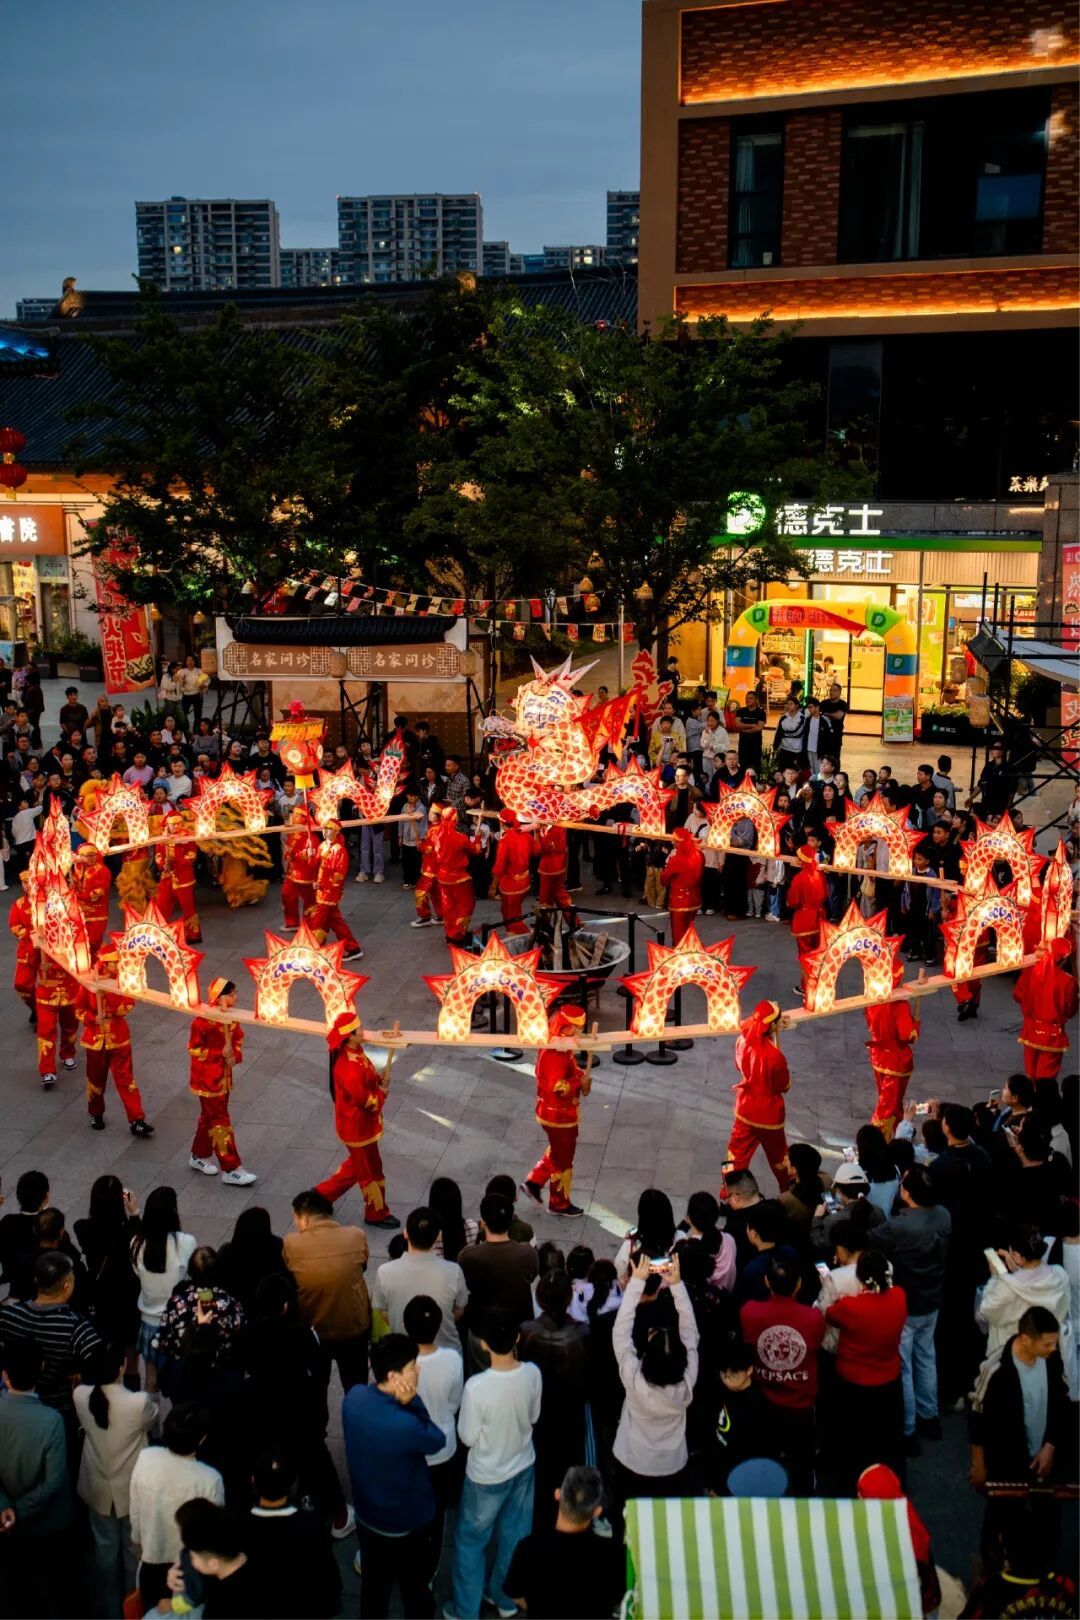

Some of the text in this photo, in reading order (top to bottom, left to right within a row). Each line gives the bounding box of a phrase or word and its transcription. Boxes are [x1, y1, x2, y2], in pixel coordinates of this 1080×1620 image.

[775, 503, 884, 535] 德克士
[808, 550, 894, 574] 德克士
[249, 651, 311, 667] 名家问诊
[373, 652, 437, 669] 名家问诊
